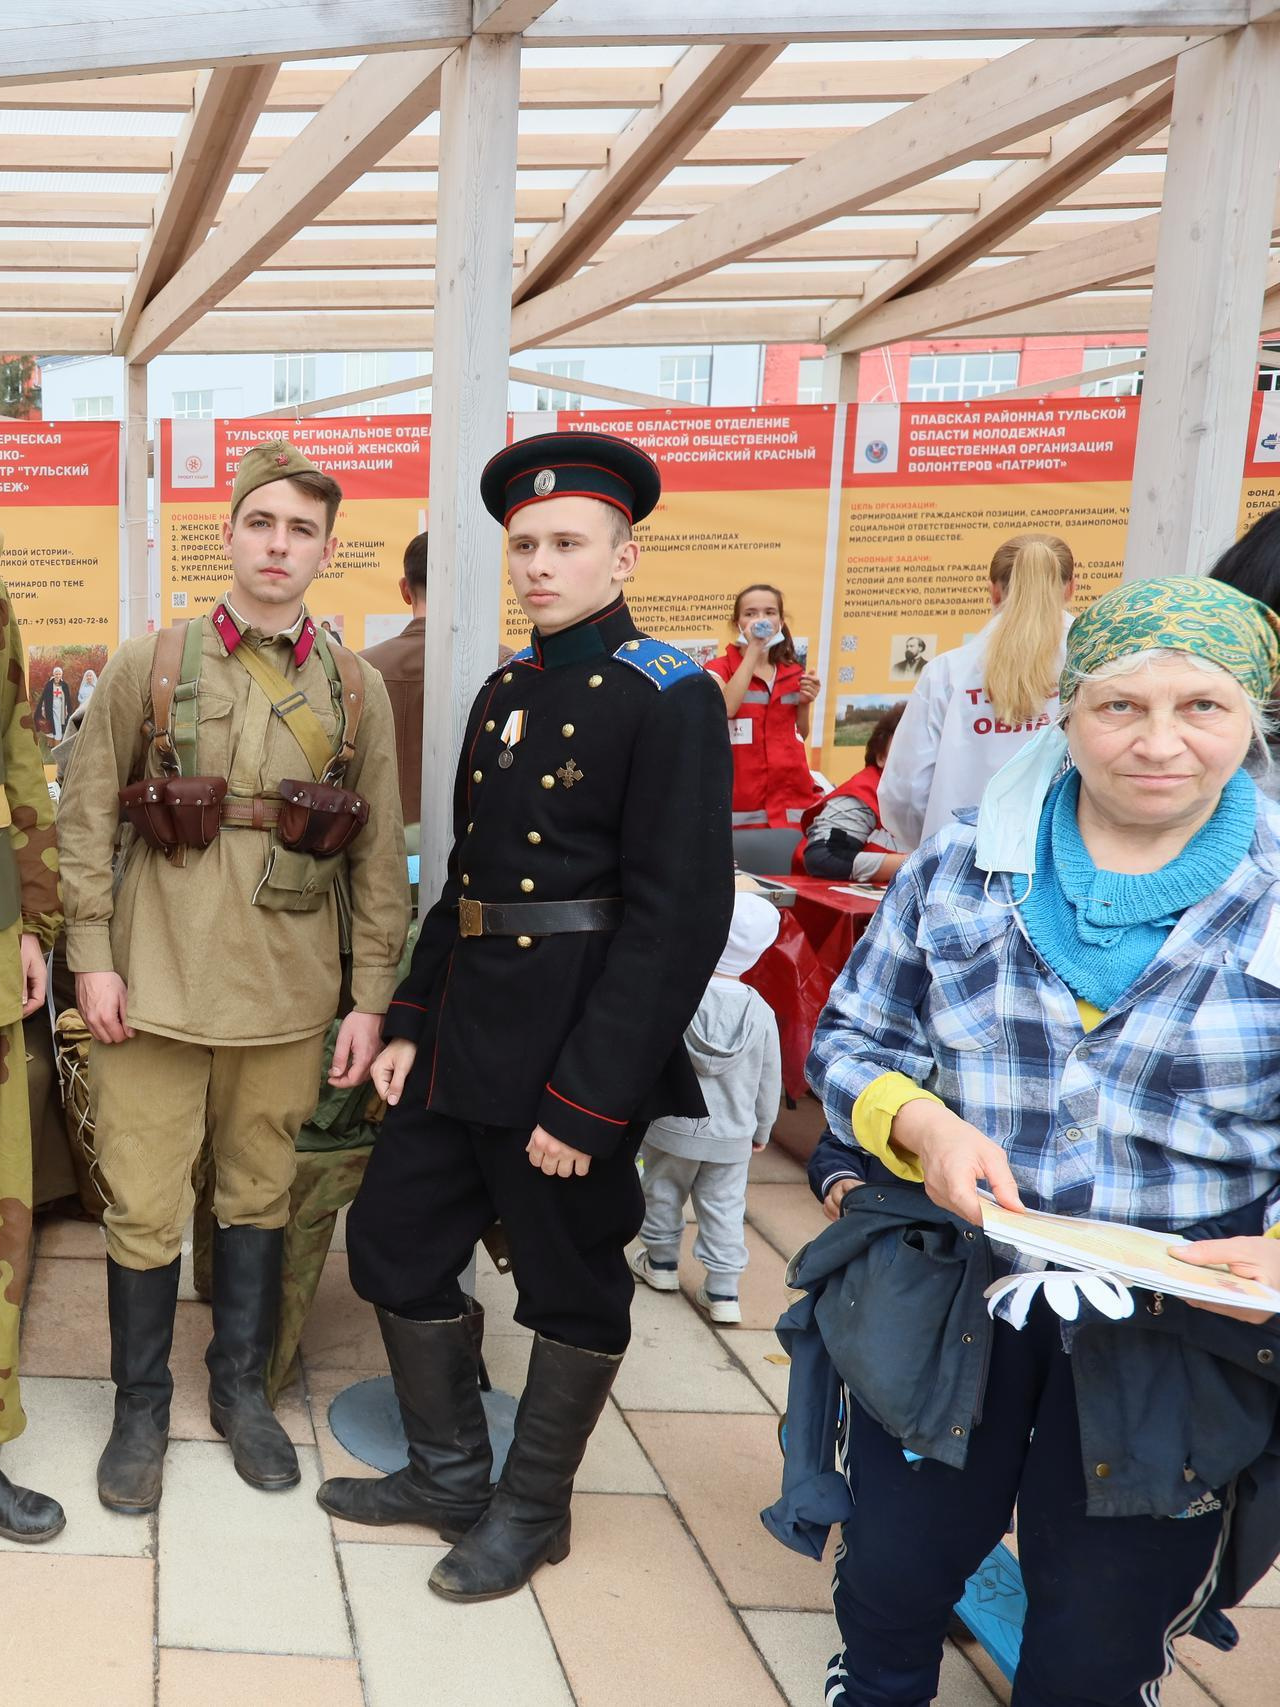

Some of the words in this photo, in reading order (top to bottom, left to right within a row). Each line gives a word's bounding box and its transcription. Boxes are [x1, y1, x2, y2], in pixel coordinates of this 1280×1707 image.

[911, 413, 980, 425] ПЛАВСКАЯ
[984, 409, 1054, 423] РАЙОННАЯ
[1058, 406, 1126, 421] ТУЛЬСКОЙ
[568, 422, 633, 432] ТУЛЬСКОЕ
[637, 419, 711, 431] ОБЛАСТНОЕ
[715, 418, 790, 430] ОТДЕЛЕНИЕ
[226, 430, 290, 441] ТУЛЬСКОЕ
[293, 428, 392, 440] РЕГИОНАЛЬНОЕ
[692, 431, 798, 446] ОБЩЕСТВЕННОЙ
[910, 429, 969, 441] ОБЛАСТИ
[973, 427, 1066, 439] МОЛОДЕЖНАЯ
[358, 440, 420, 454] ЖЕНСКОЙ
[909, 444, 1016, 457] ОБЩЕСТВЕННАЯ
[1020, 441, 1113, 454] ОРГАНИЗАЦИЯ
[661, 448, 751, 462] «РОССИЙСКИЙ
[754, 446, 816, 460] КРАСНЫЙ
[312, 460, 393, 471] РГАНИЗАЦИИ
[908, 460, 992, 472] ВОЛОНТЕРОВ
[996, 458, 1067, 471] «ПАТРИОТ»
[1247, 489, 1275, 497] ФОНД
[851, 503, 873, 511] ЦЕЛЬ
[921, 510, 983, 519] ГРАЖДАНСКОЙ
[850, 523, 905, 532] СОЦИАЛЬНОЙ
[849, 535, 905, 543] МИЛОСЕРДИЯ
[729, 542, 781, 550] КАТЕГОРИЯМ
[30, 557, 98, 566] ОТЕЧЕСТВЕННОЙ
[847, 556, 892, 564] ОСНОВНЫЕ
[847, 566, 901, 574] ВОСПИТАНИЕ
[903, 565, 945, 573] МОЛОДЫХ
[947, 564, 988, 572] ГРАЖДАН
[846, 576, 885, 585] УСЛОВИЙ
[646, 594, 725, 602] МЕЖДУНАРОДНОГО
[844, 599, 922, 607] МУНИЦИПАЛЬНОГО
[924, 597, 984, 606] ОБРАЗОВАНИЯ
[843, 610, 897, 618] ВОВЛЕЧЕНИЕ
[900, 609, 948, 617] МОЛОДЕЖИ
[958, 608, 991, 616] ВОЛОНТ
[46, 617, 66, 626] (953)
[69, 617, 109, 625] 420-72-86
[638, 624, 714, 632] НИВЕРСАЛЬНОСТЬ.
